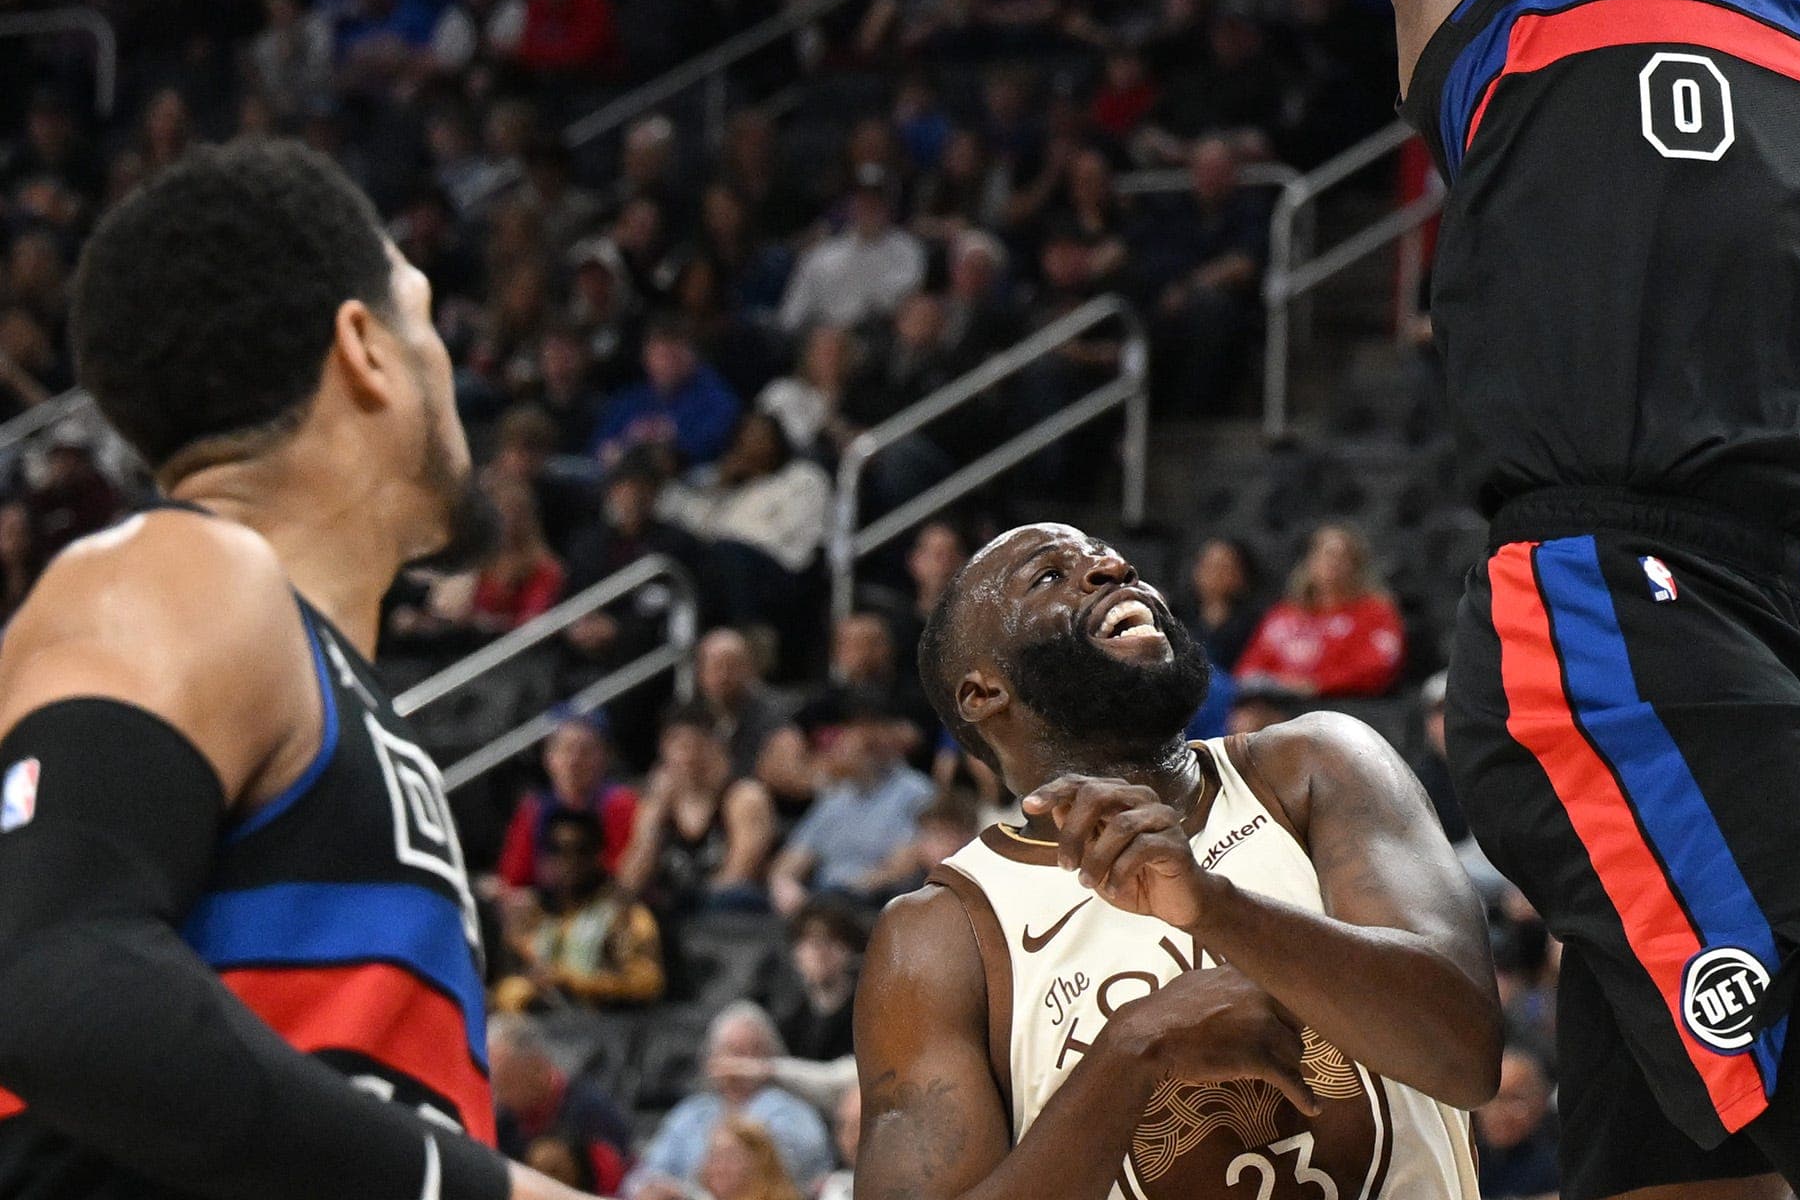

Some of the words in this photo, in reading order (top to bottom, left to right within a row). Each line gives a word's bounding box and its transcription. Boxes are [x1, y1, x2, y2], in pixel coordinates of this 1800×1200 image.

[1639, 52, 1735, 161] 0
[1201, 814, 1268, 870] akuten
[1045, 972, 1090, 1026] The
[1695, 969, 1757, 1025] DET
[1226, 1131, 1339, 1200] 23
